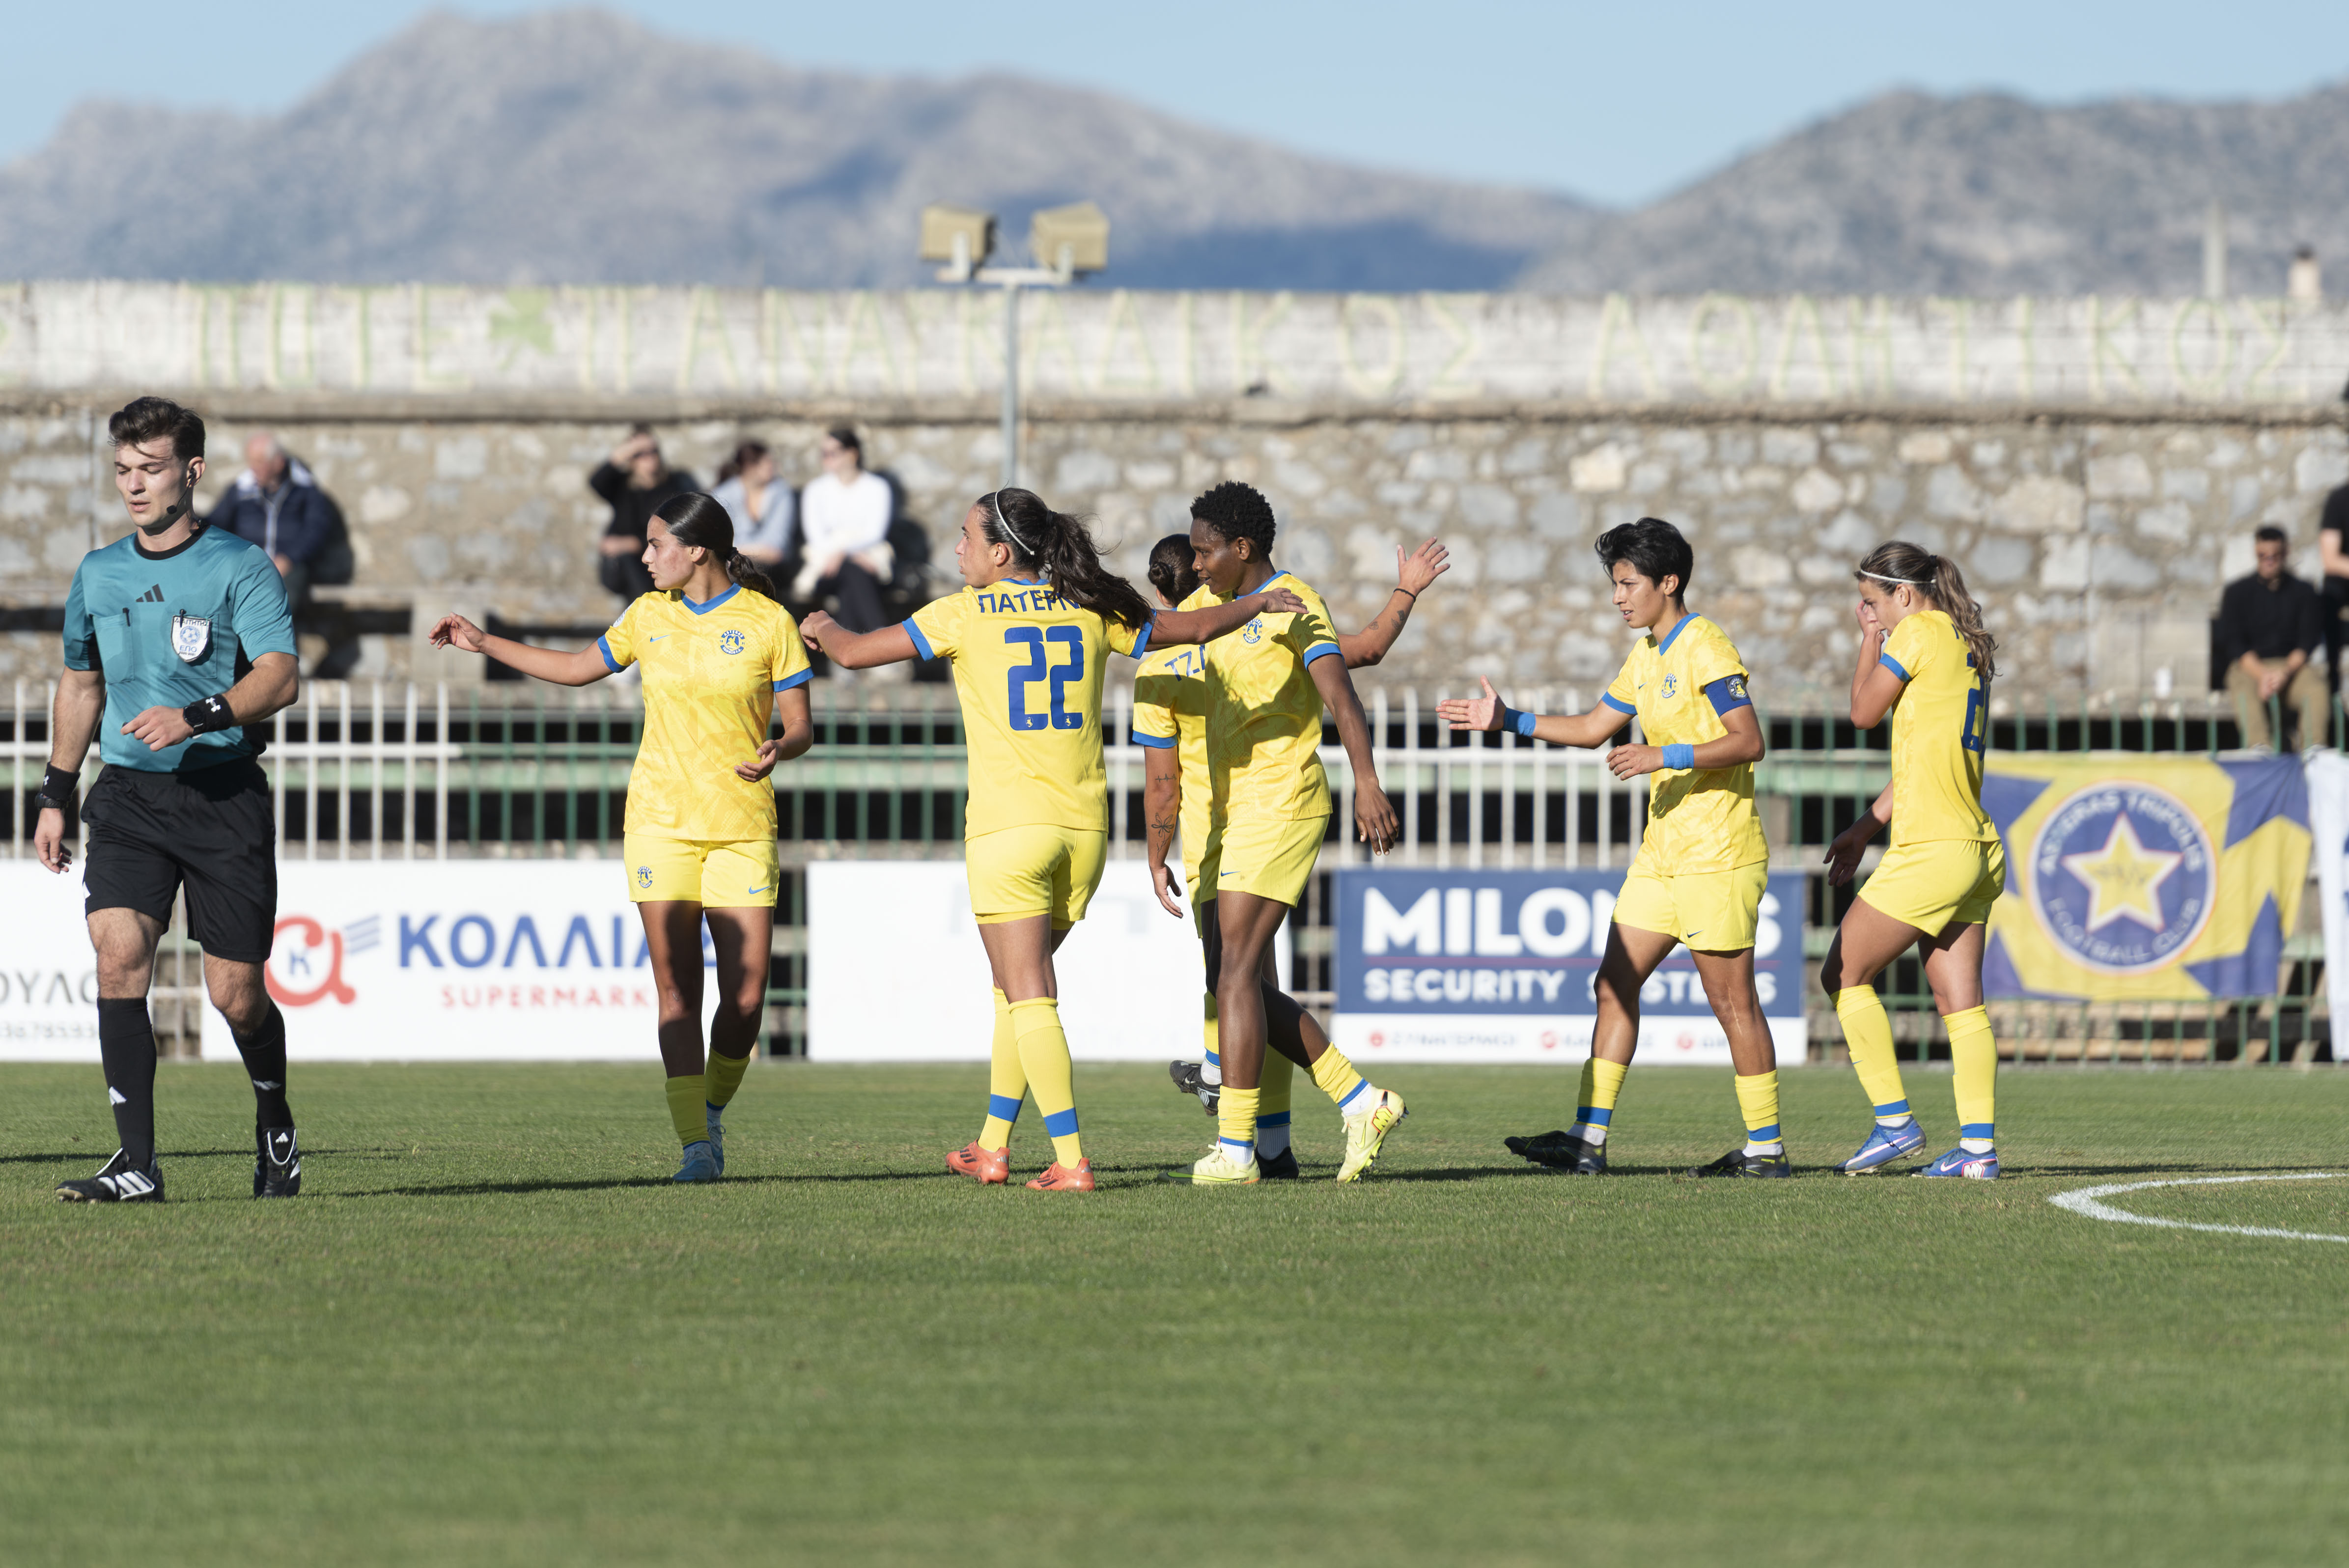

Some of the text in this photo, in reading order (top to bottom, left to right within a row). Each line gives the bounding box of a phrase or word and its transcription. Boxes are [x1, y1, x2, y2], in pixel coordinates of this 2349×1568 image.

[1586, 292, 2310, 403] ΑΘΛΗΤΙΚΟΣ
[174, 617, 208, 626] ΔΑΙΤΗΤΗΣ
[978, 589, 1080, 613] ΠΑΤΕΡΝ
[1005, 626, 1083, 730] 22
[1362, 887, 1782, 958] MILOS
[2046, 897, 2201, 964] FOOTBALL CLUB
[442, 985, 659, 1008] SUPERMARK
[1364, 968, 1777, 1005] SECURITY STES
